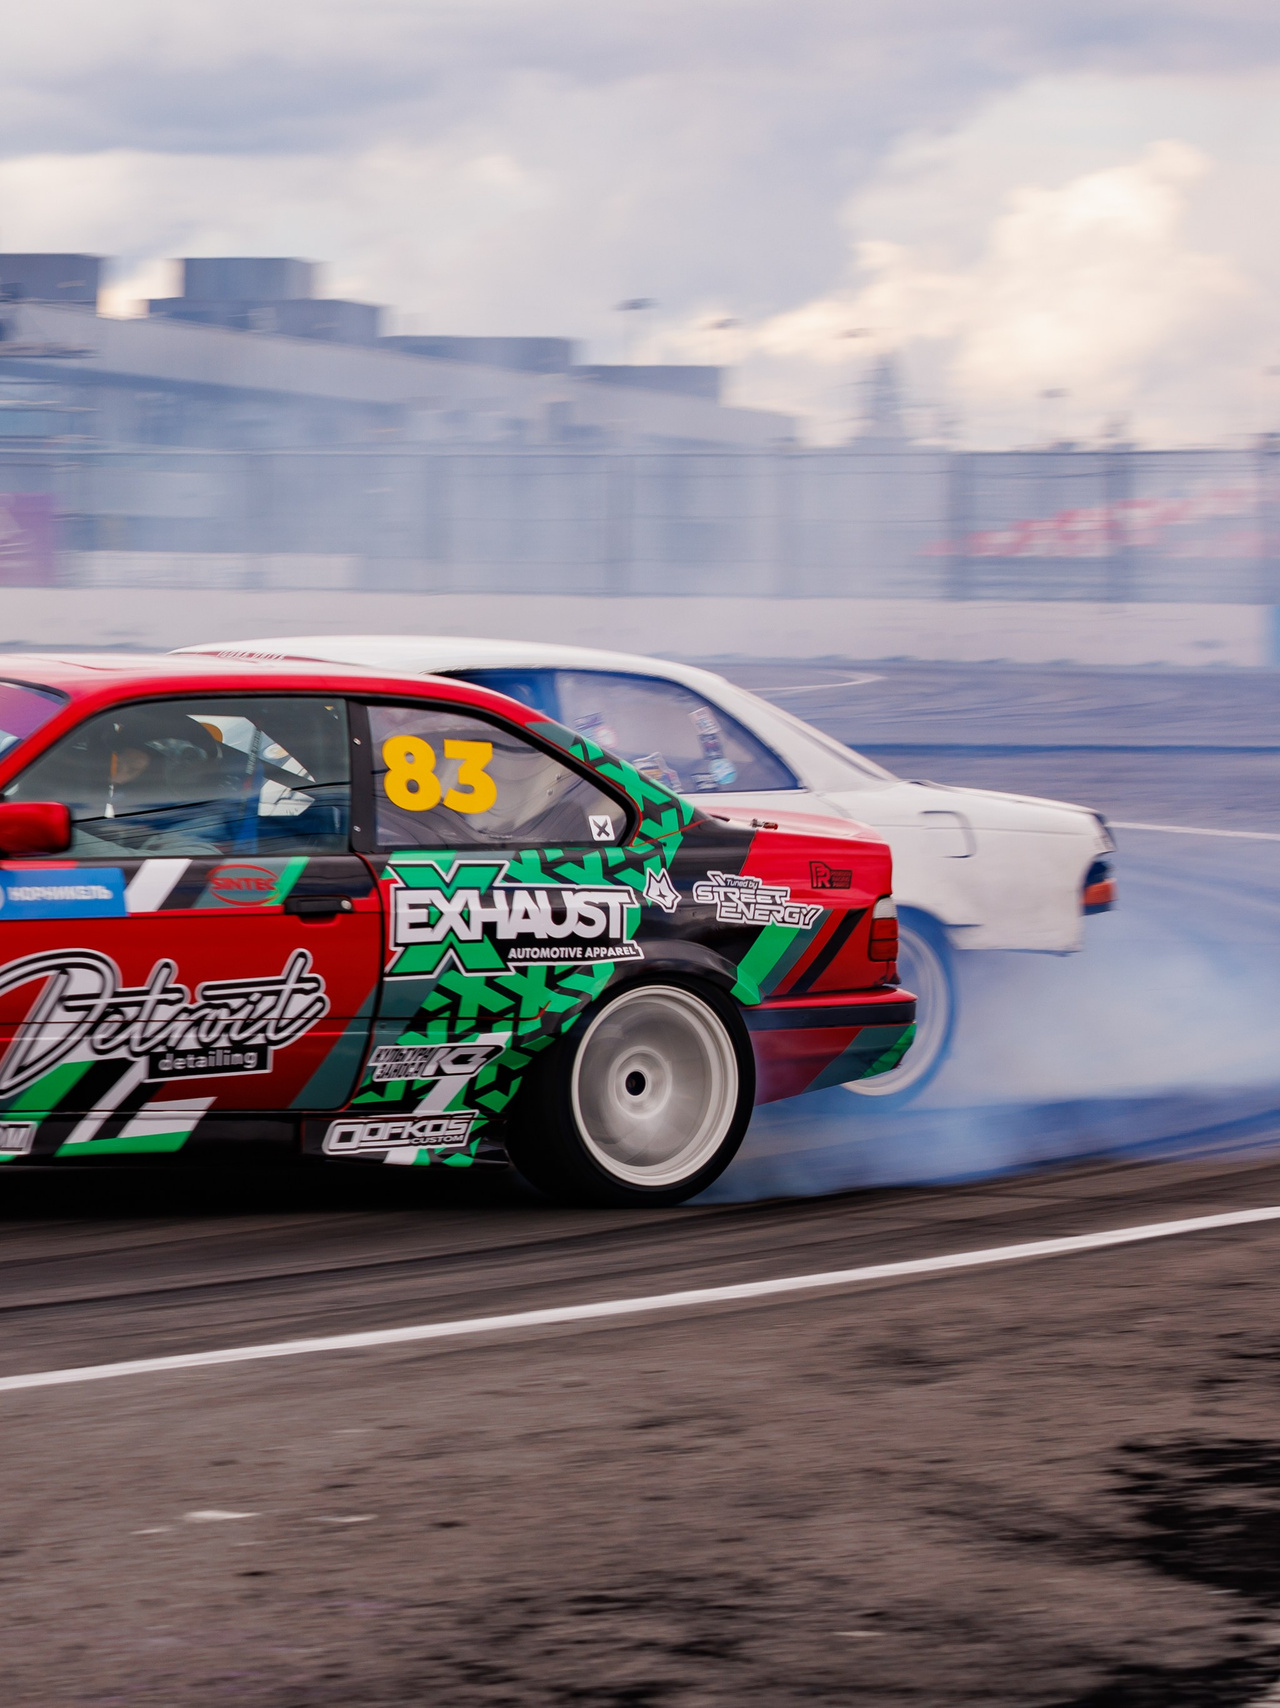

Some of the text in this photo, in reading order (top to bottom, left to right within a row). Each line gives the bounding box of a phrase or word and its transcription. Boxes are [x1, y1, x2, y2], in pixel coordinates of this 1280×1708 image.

[382, 735, 497, 814] 83
[696, 885, 787, 905] STREET
[727, 879, 758, 890] Tuned by
[395, 888, 632, 943] EXHAUST
[720, 902, 820, 925] ENERGY
[507, 946, 637, 960] AUTOMOTIVE APPAREL
[158, 1049, 258, 1071] detailing
[410, 1135, 464, 1145] CUSTOM
